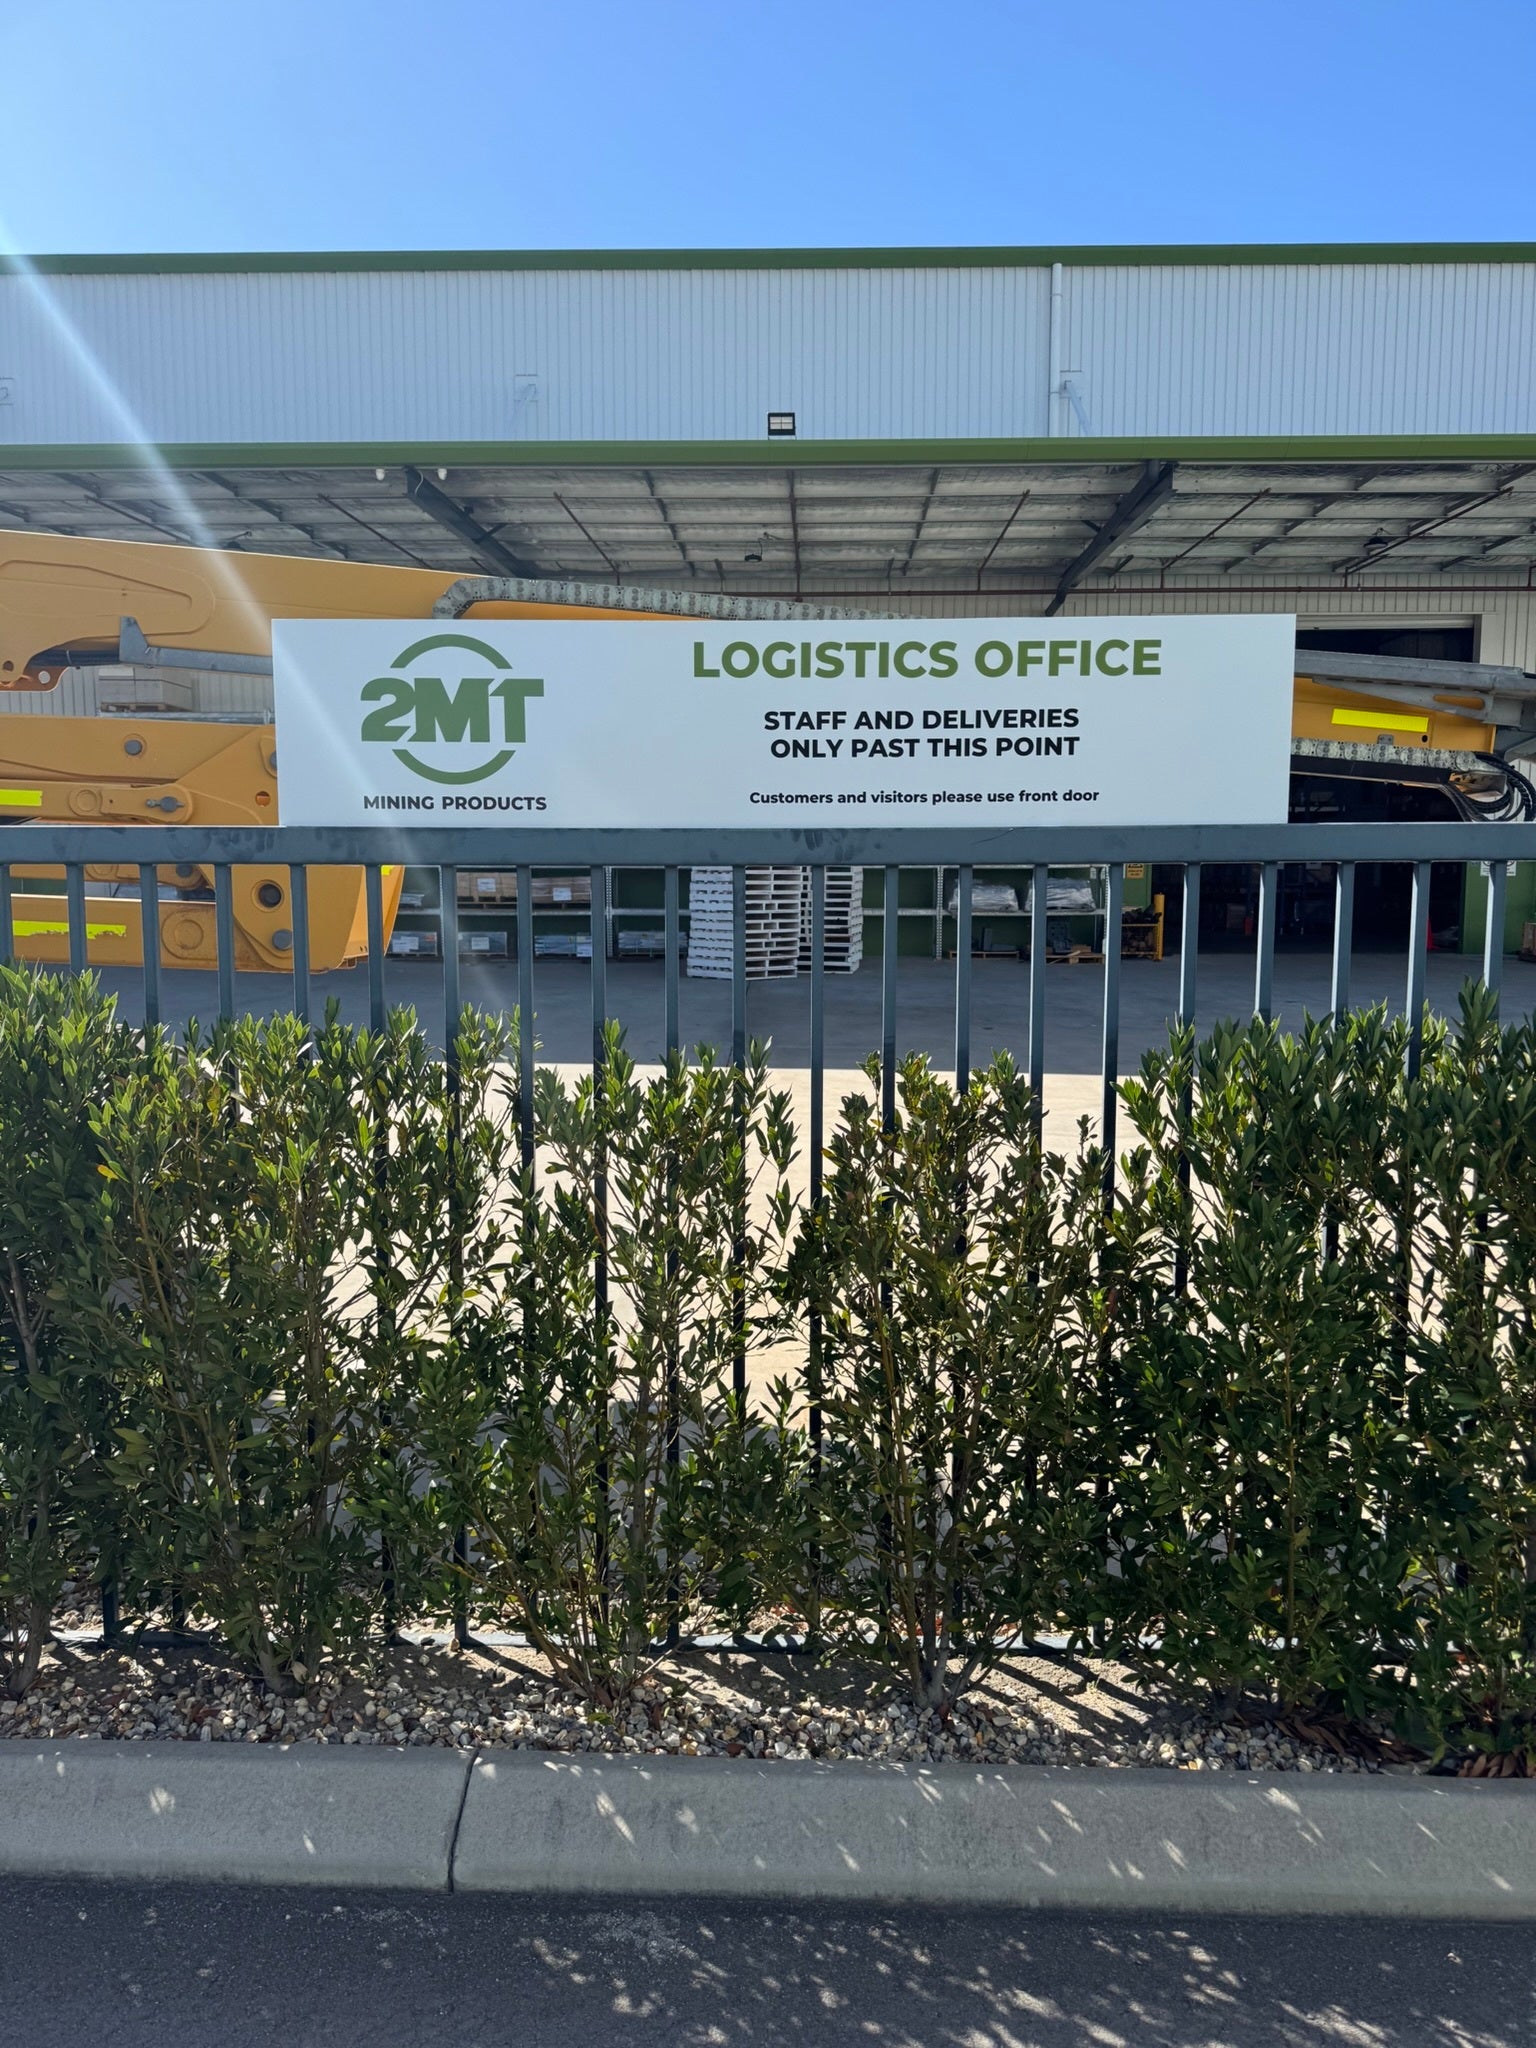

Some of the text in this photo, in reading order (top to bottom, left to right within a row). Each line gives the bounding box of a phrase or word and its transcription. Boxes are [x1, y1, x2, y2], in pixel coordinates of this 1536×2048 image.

[693, 639, 1162, 679] LOGISTICS OFFICE
[360, 677, 545, 744] 2MT
[764, 707, 1080, 731] STAFF AND DELIVERIES
[770, 736, 1081, 759] ONLY PAST THIS POINT
[363, 795, 547, 811] MINING PRODUCTS
[749, 788, 1100, 806] Customers and visitors please use front door
